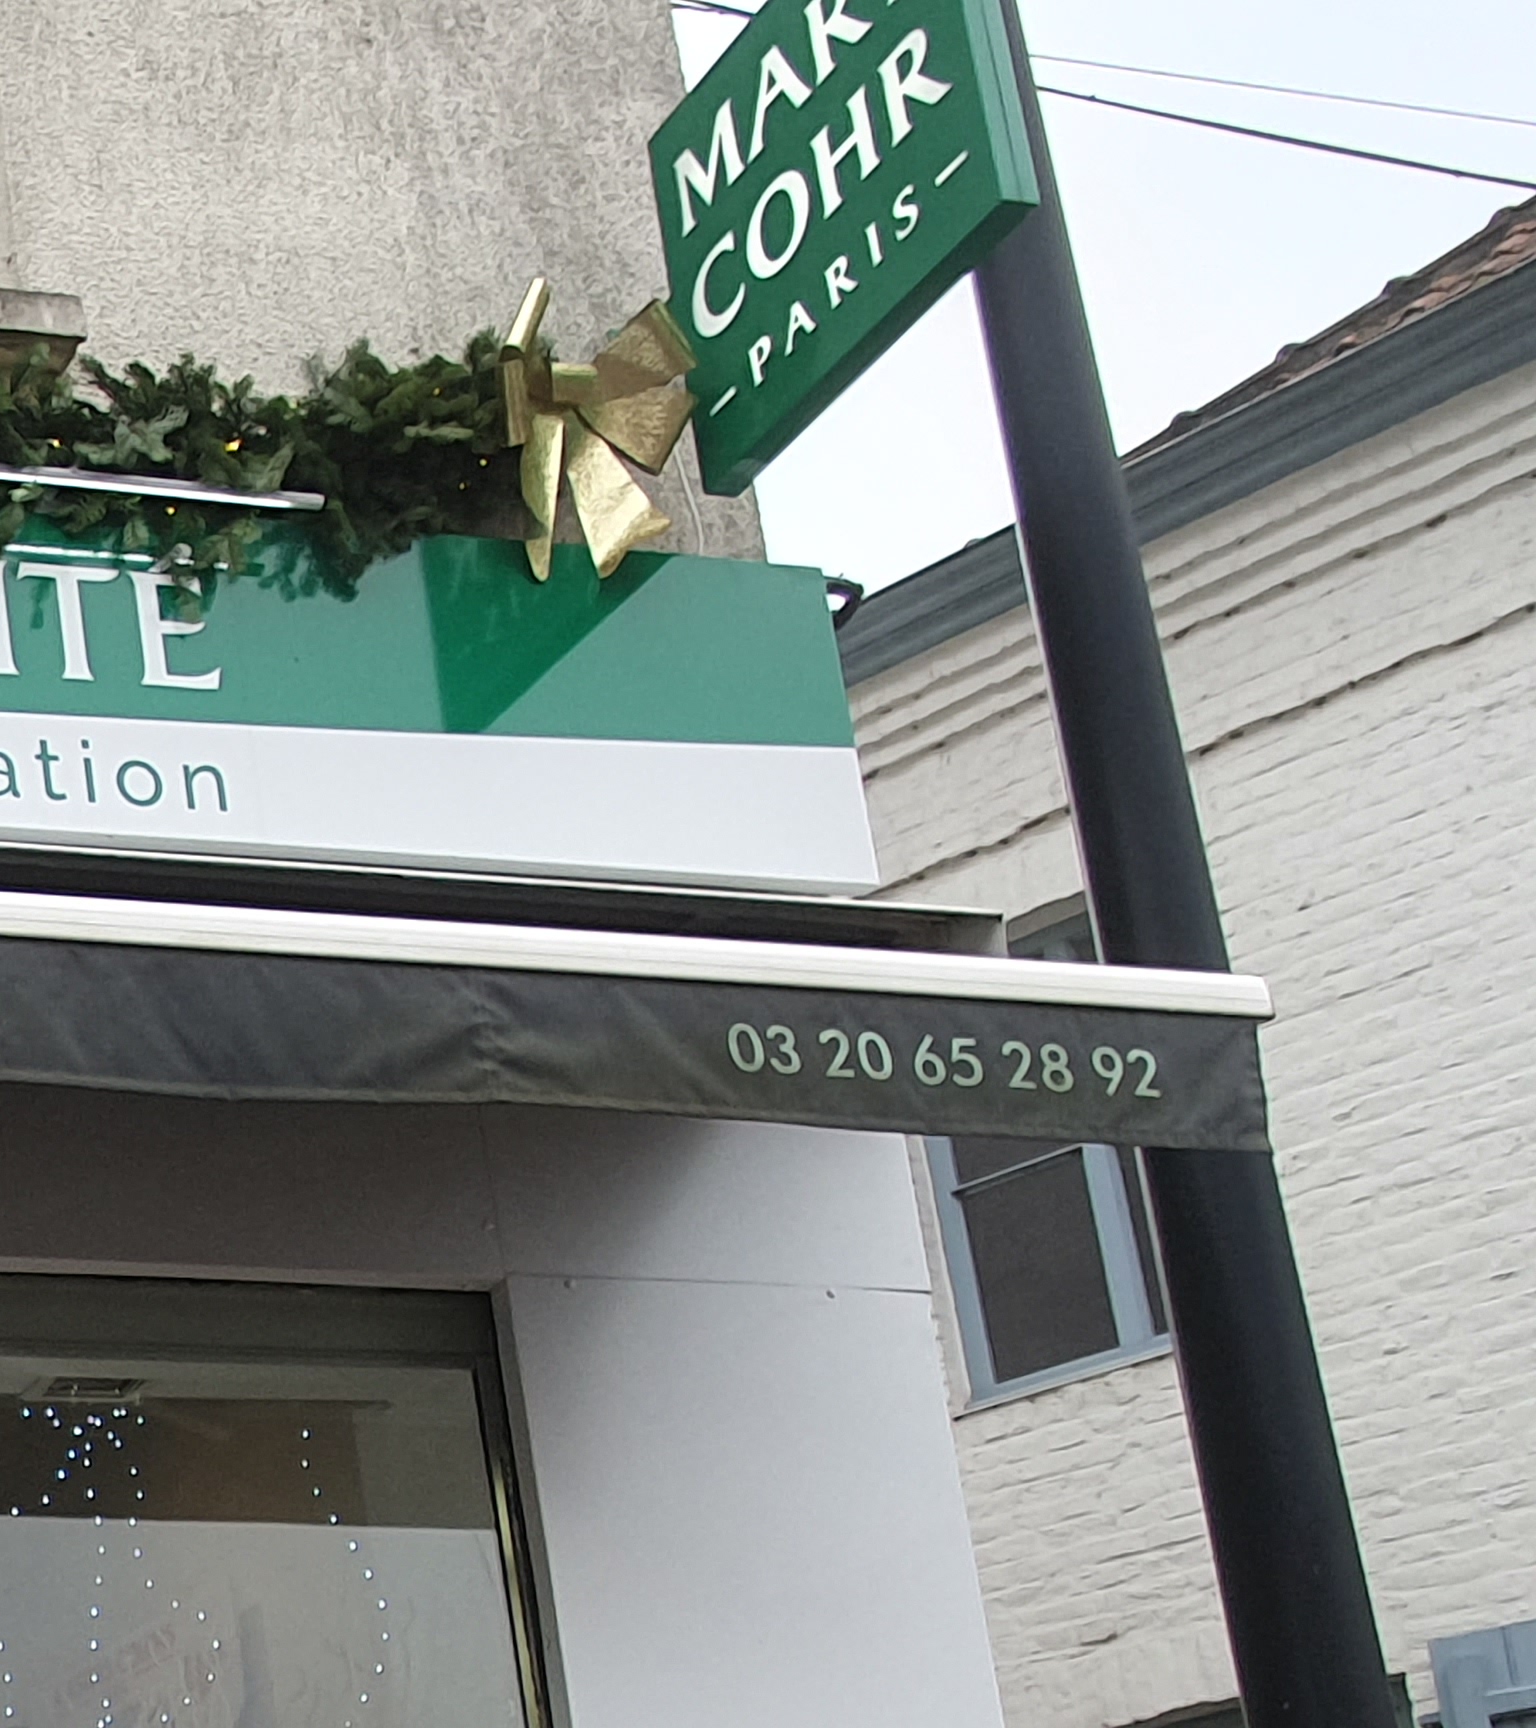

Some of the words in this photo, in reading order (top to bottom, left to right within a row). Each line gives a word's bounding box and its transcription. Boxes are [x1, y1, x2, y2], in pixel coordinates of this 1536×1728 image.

[673, 0, 898, 238] MAR
[691, 28, 954, 339] COHR
[747, 184, 921, 388] PARIS
[728, 1022, 803, 1076] 03
[818, 1028, 894, 1082] 20
[913, 1034, 985, 1088] 65
[1001, 1040, 1075, 1093] 28
[1091, 1046, 1162, 1099] 92
